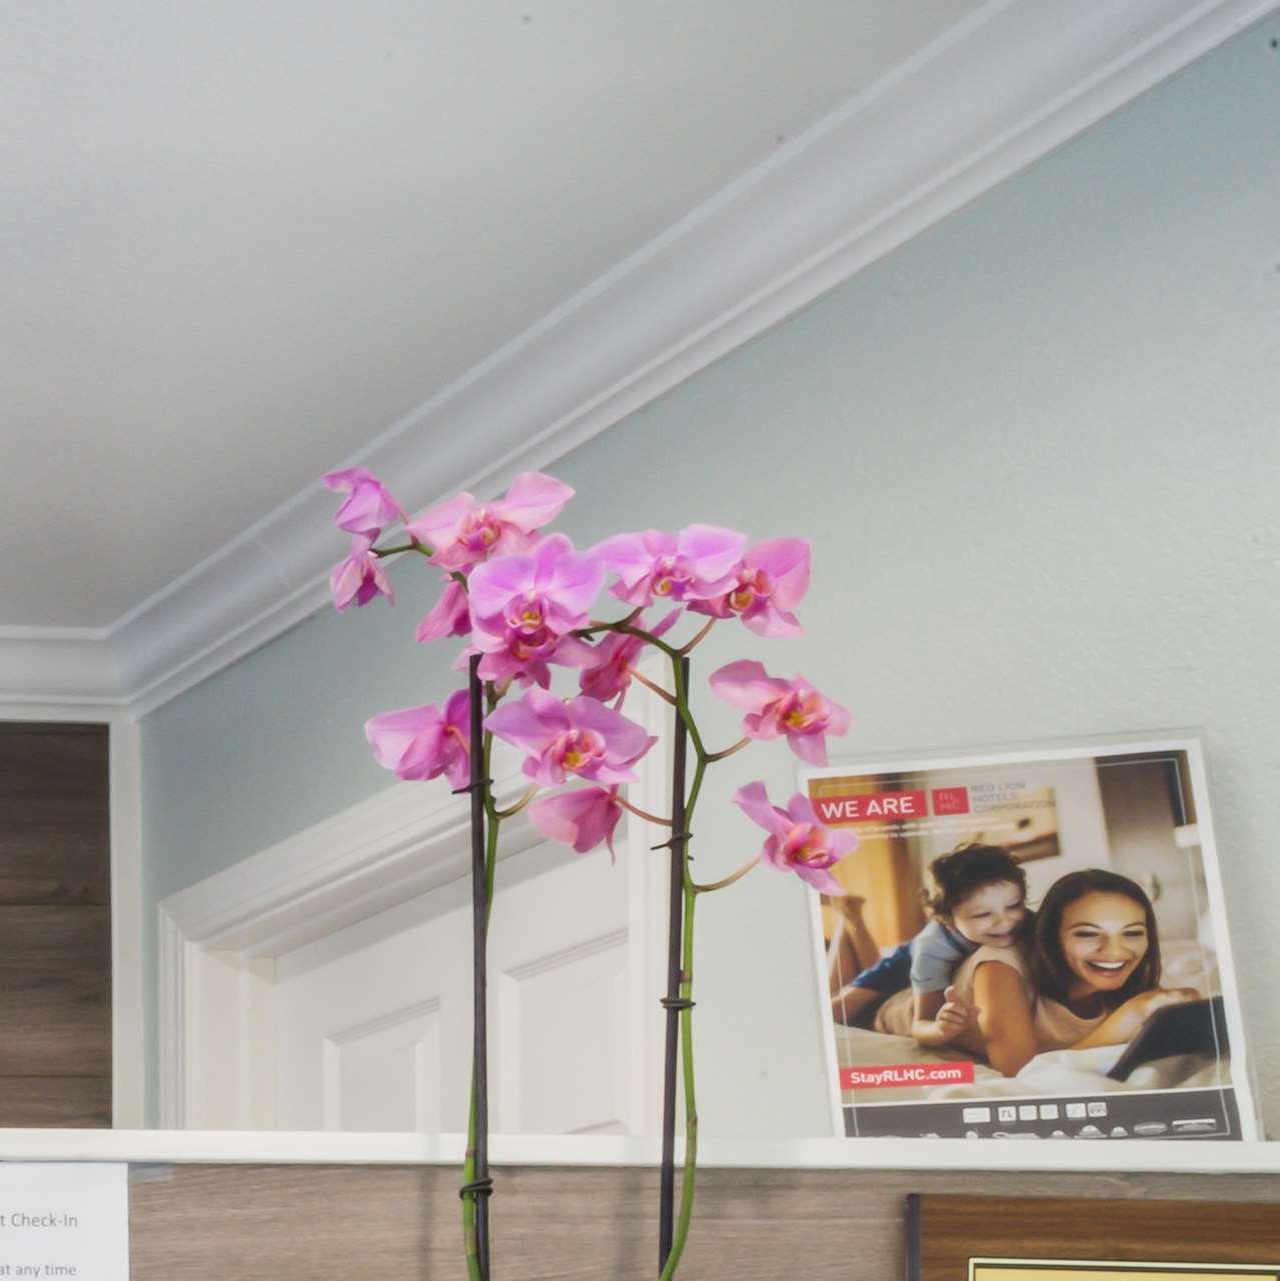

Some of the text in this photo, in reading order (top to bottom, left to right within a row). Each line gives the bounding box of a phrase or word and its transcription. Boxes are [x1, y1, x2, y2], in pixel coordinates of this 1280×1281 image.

[821, 796, 915, 819] WE ARE
[849, 1069, 962, 1085] StayRLHC.com
[10, 1212, 79, 1228] Check-In
[15, 1265, 42, 1279] any
[44, 1263, 77, 1277] time
